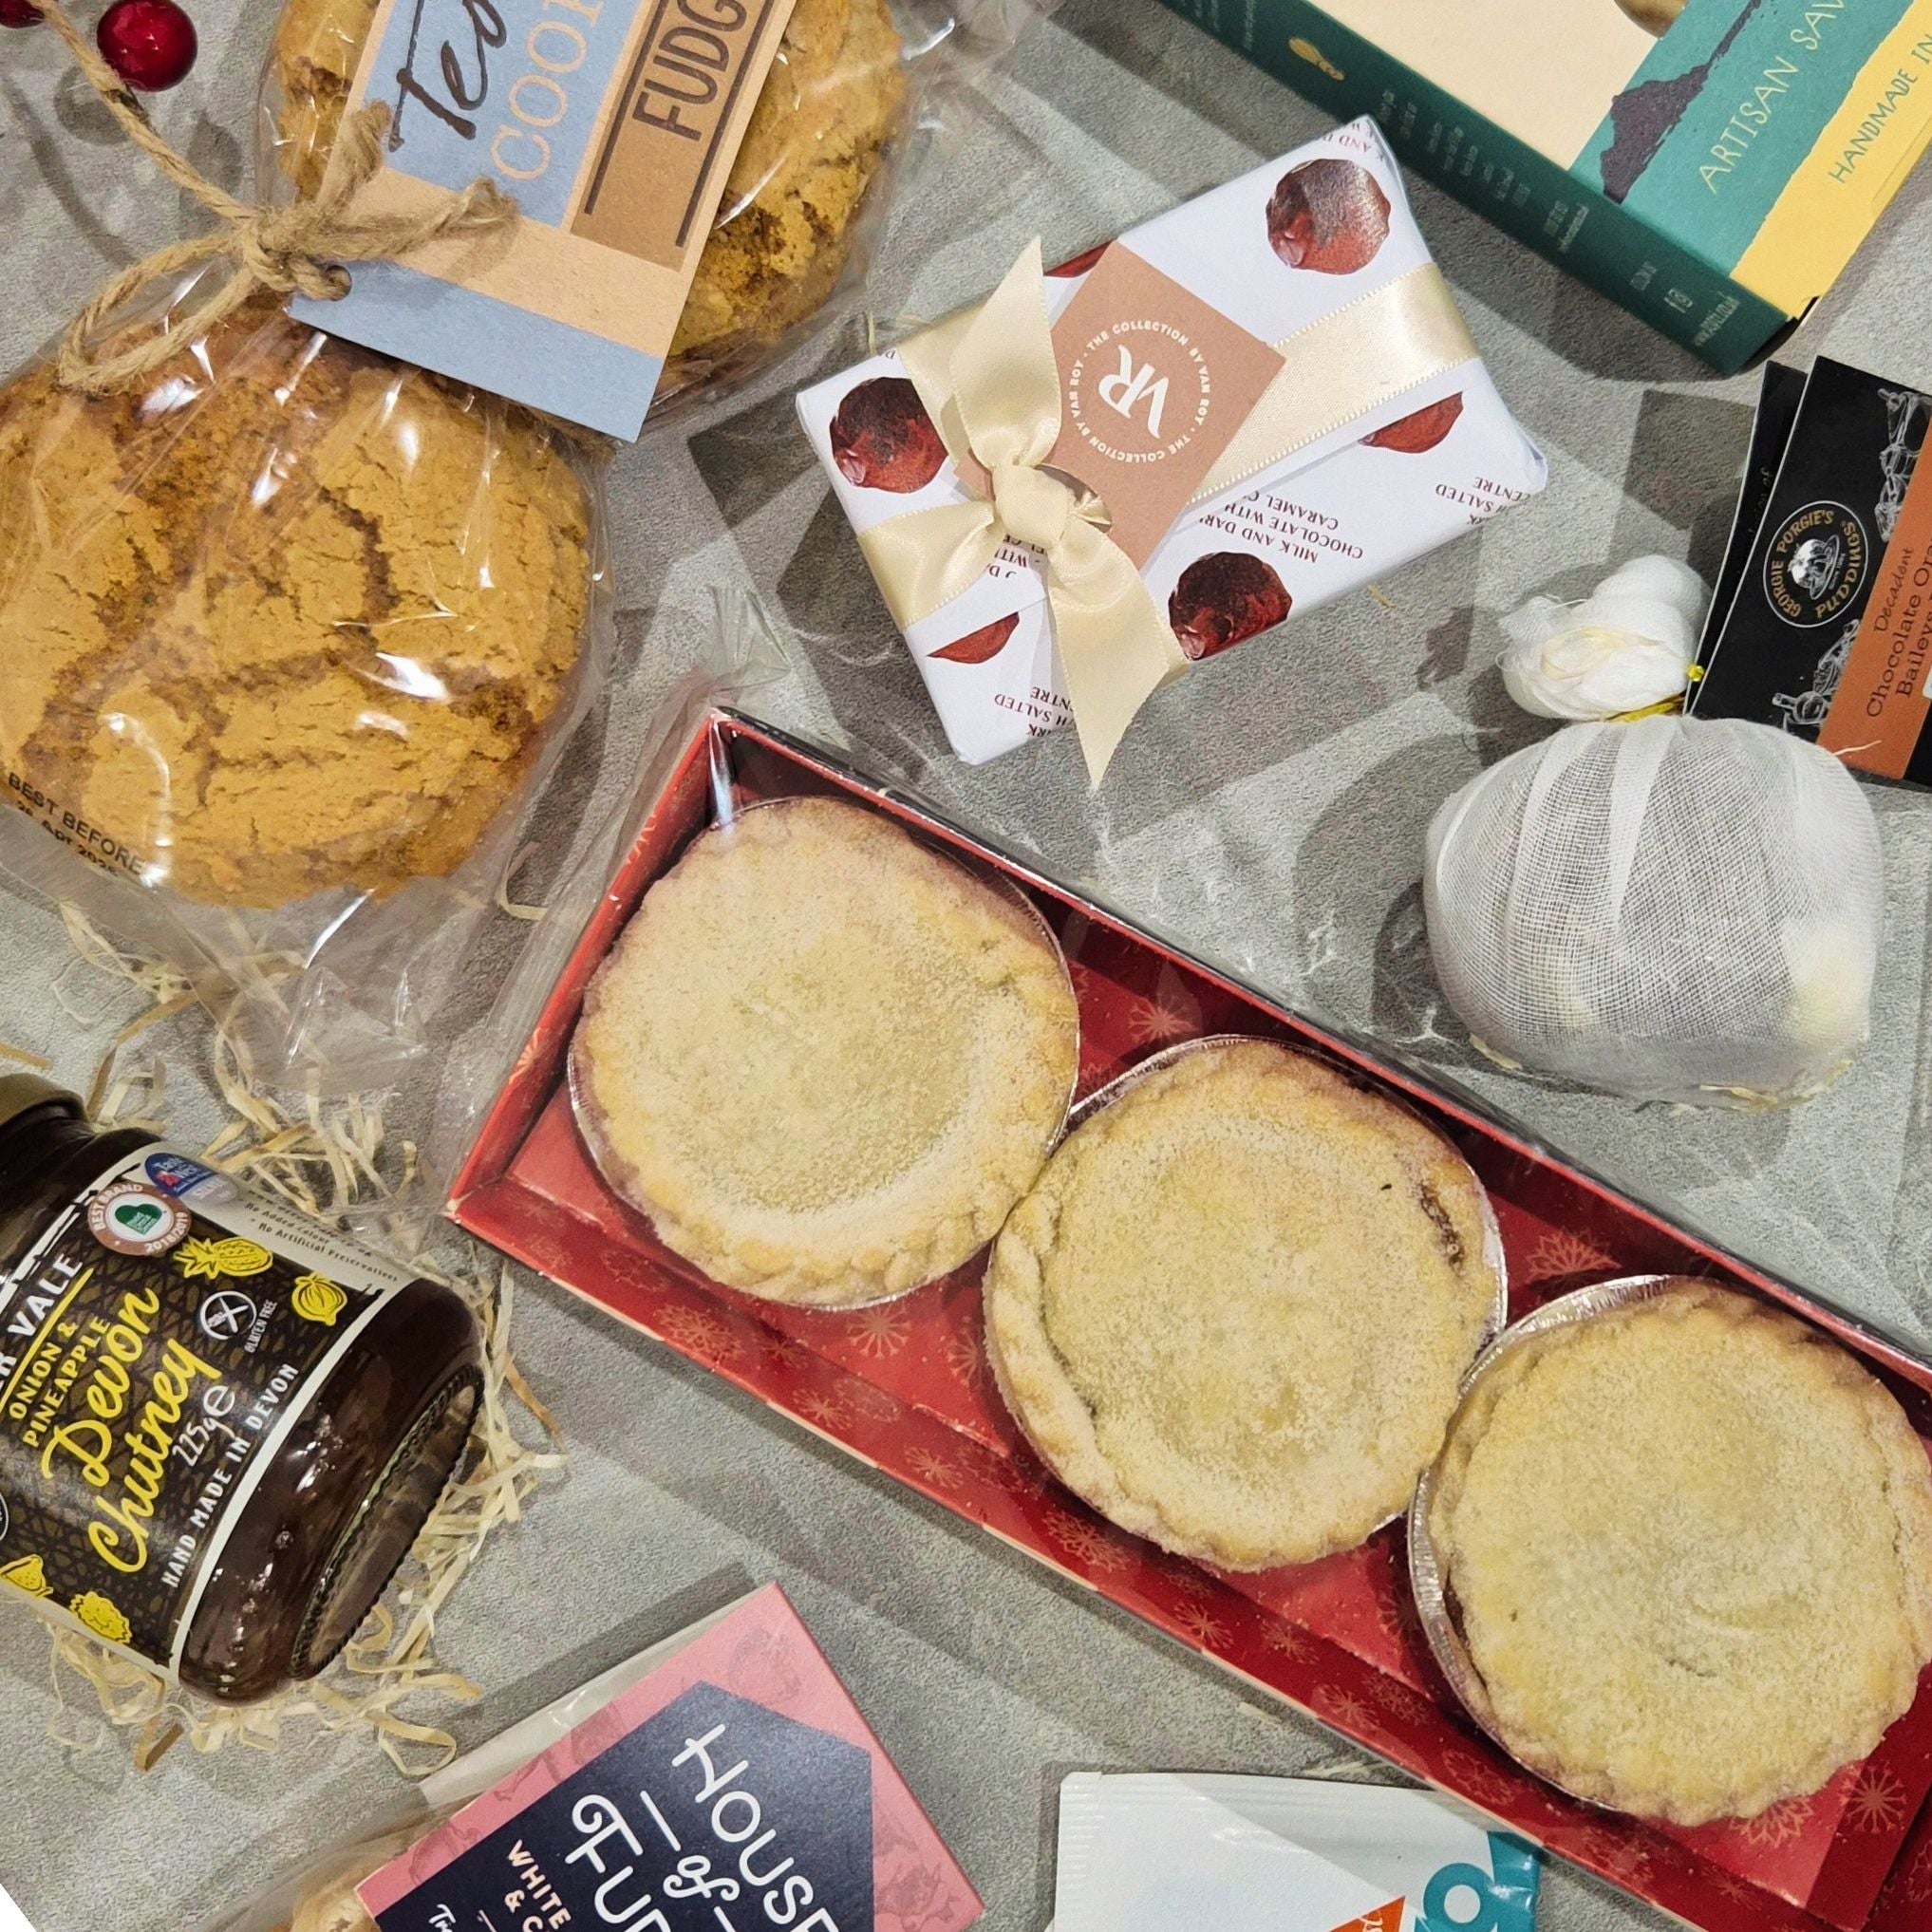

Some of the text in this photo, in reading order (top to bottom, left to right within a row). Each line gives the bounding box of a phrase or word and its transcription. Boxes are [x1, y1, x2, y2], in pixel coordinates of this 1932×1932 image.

[1699, 55, 1798, 194] ARTISAN
[1829, 68, 1919, 183] HANDMADE
[1069, 359, 1191, 463] THE COLLECTION BY VAN ROY
[1086, 320, 1210, 425] THE COLLECTION BY VAN ROY
[1098, 344, 1169, 439] VR
[1199, 514, 1318, 563] MILK AND DAR
[1267, 494, 1339, 531] CARAMEL
[1269, 516, 1363, 559] CHOCOLATE
[1435, 483, 1494, 513] SALTED
[1771, 510, 1834, 617] GEORGIE PORGIE'S
[1873, 548, 1914, 631] Decadent
[1866, 593, 1922, 718] Chocolate
[994, 694, 1052, 722] SALTED
[9, 772, 145, 875] BEST BEFORE
[91, 1204, 105, 1231] BEST
[99, 1183, 143, 1203] BRAND
[144, 1211, 188, 1253] 2018/2019
[262, 1210, 295, 1228] Added
[8, 1253, 83, 1337] VALE
[258, 1222, 398, 1282] No Artificial Preservatives
[244, 1299, 278, 1353] GLUTEN FREE
[9, 1342, 63, 1419] ONION
[57, 1322, 79, 1338] &
[23, 1316, 111, 1448] PINEAPPLE
[42, 1288, 159, 1488] Devon
[87, 1338, 223, 1572] Chutney
[160, 1363, 299, 1588] HAND MADE IN DEVON
[504, 1889, 525, 1913] &
[508, 1839, 572, 1930] WHITE
[664, 1855, 741, 1901] of
